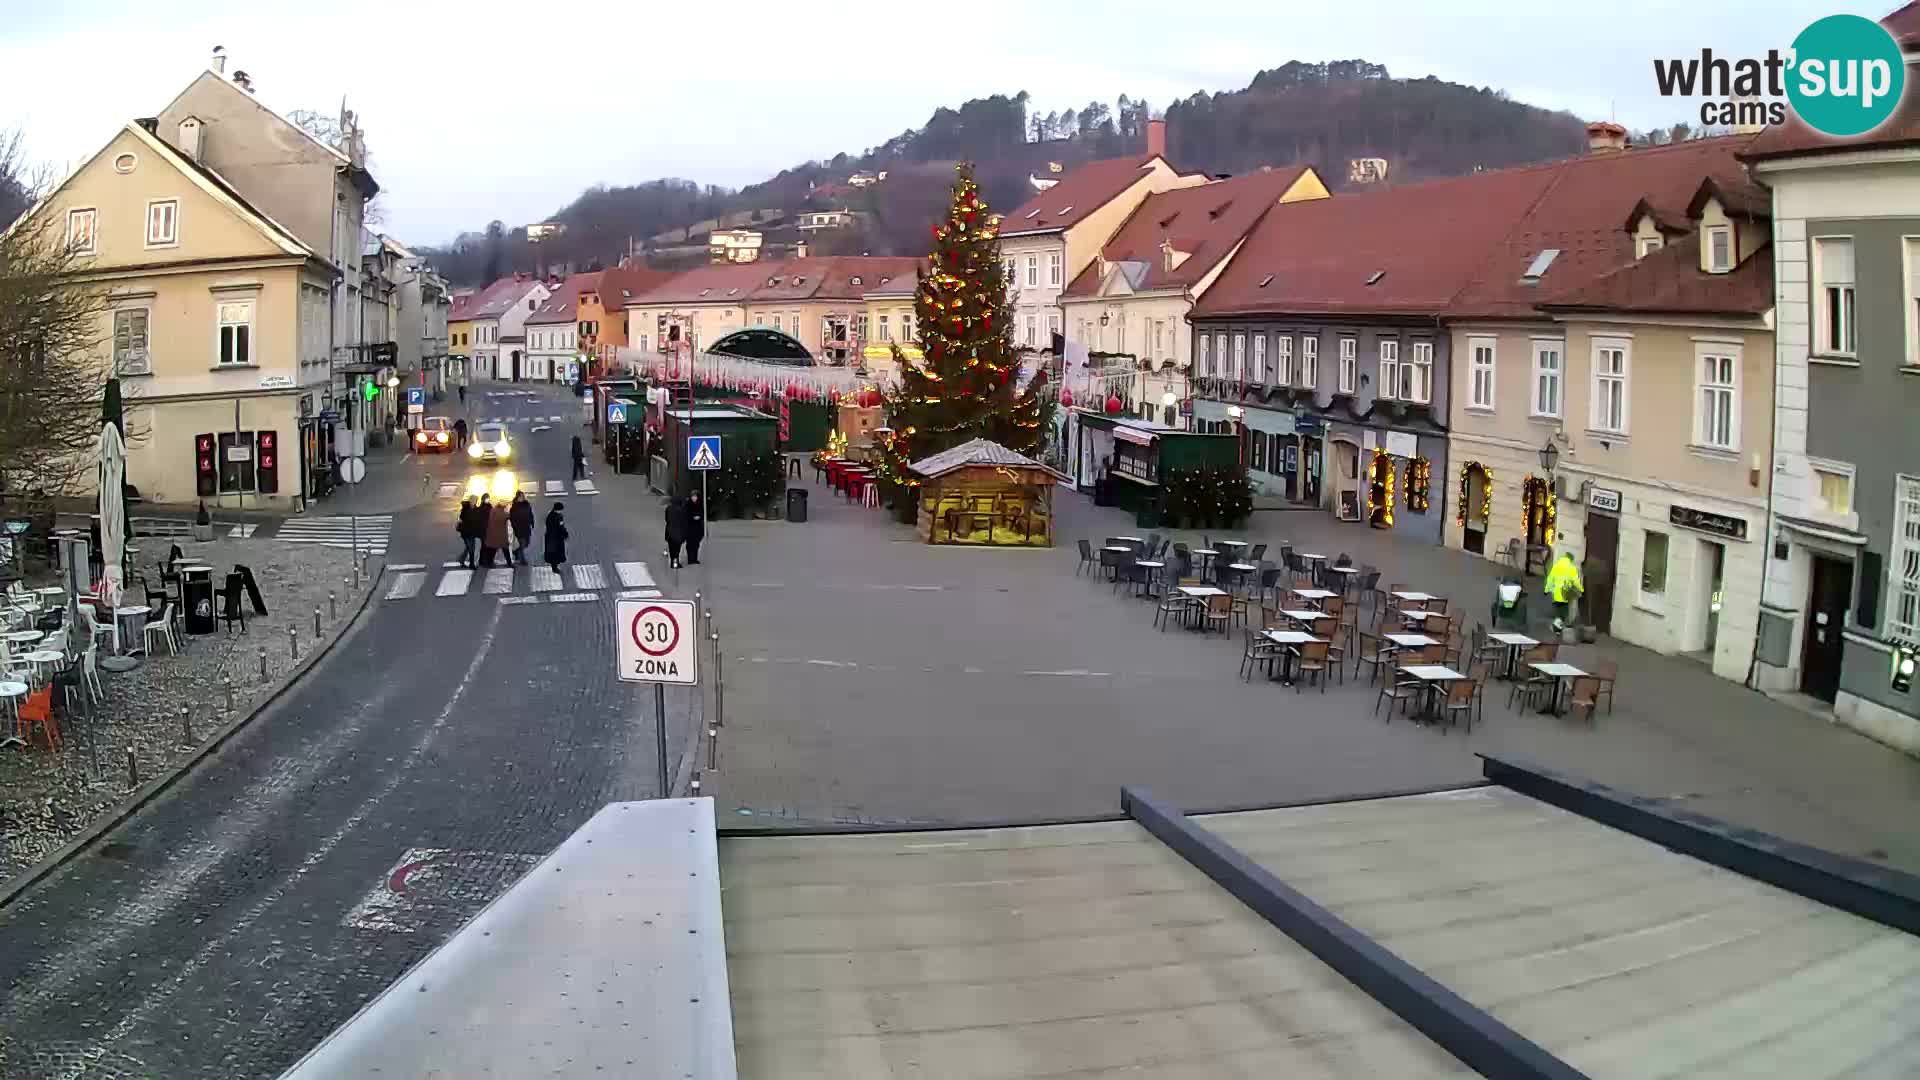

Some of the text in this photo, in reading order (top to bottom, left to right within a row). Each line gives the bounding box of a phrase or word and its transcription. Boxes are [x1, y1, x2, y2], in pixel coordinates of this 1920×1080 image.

[411, 391, 420, 402] P
[644, 622, 668, 643] 30
[635, 659, 679, 676] ZONA
